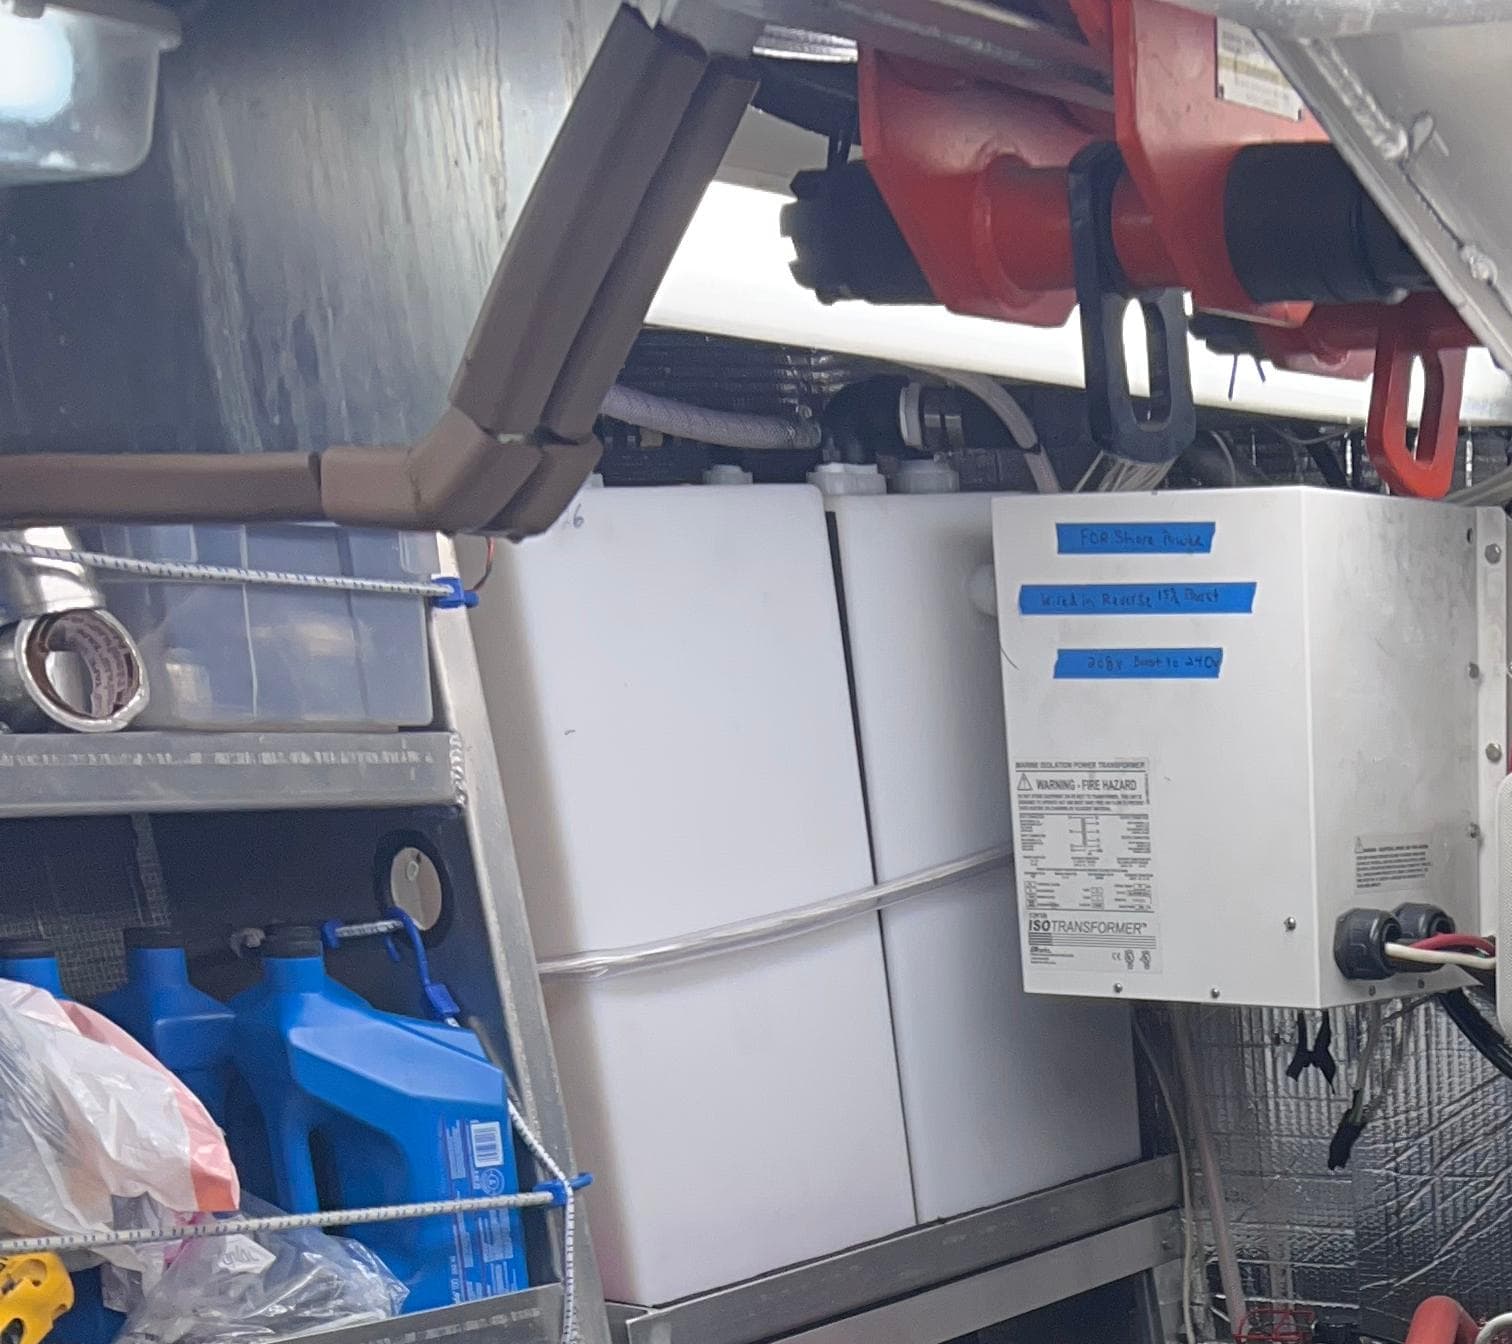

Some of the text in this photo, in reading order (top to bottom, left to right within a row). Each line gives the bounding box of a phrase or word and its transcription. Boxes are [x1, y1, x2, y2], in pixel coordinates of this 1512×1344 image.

[1036, 779, 1137, 791] WARNING FIRE HAZARD
